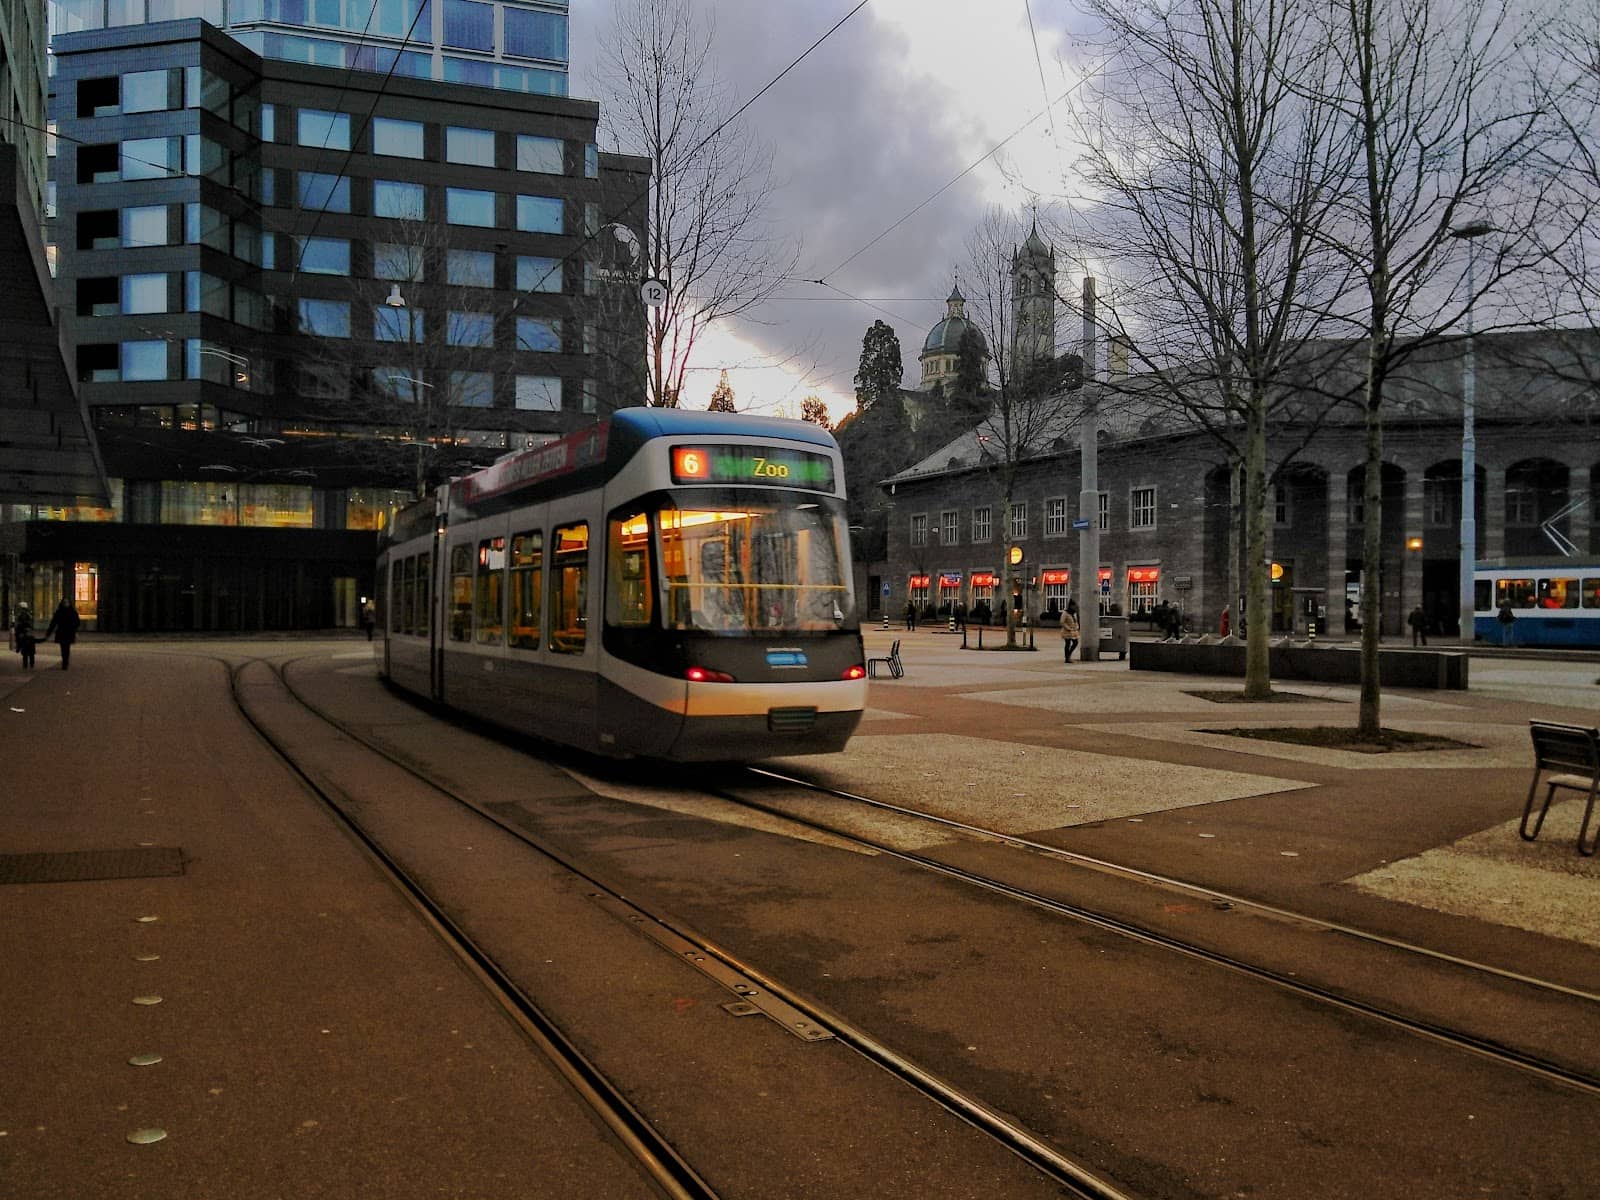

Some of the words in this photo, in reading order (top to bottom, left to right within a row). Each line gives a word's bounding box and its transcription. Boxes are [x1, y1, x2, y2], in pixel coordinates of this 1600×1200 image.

[647, 287, 661, 300] 12
[683, 453, 699, 474] 6
[752, 457, 789, 478] Zoo
